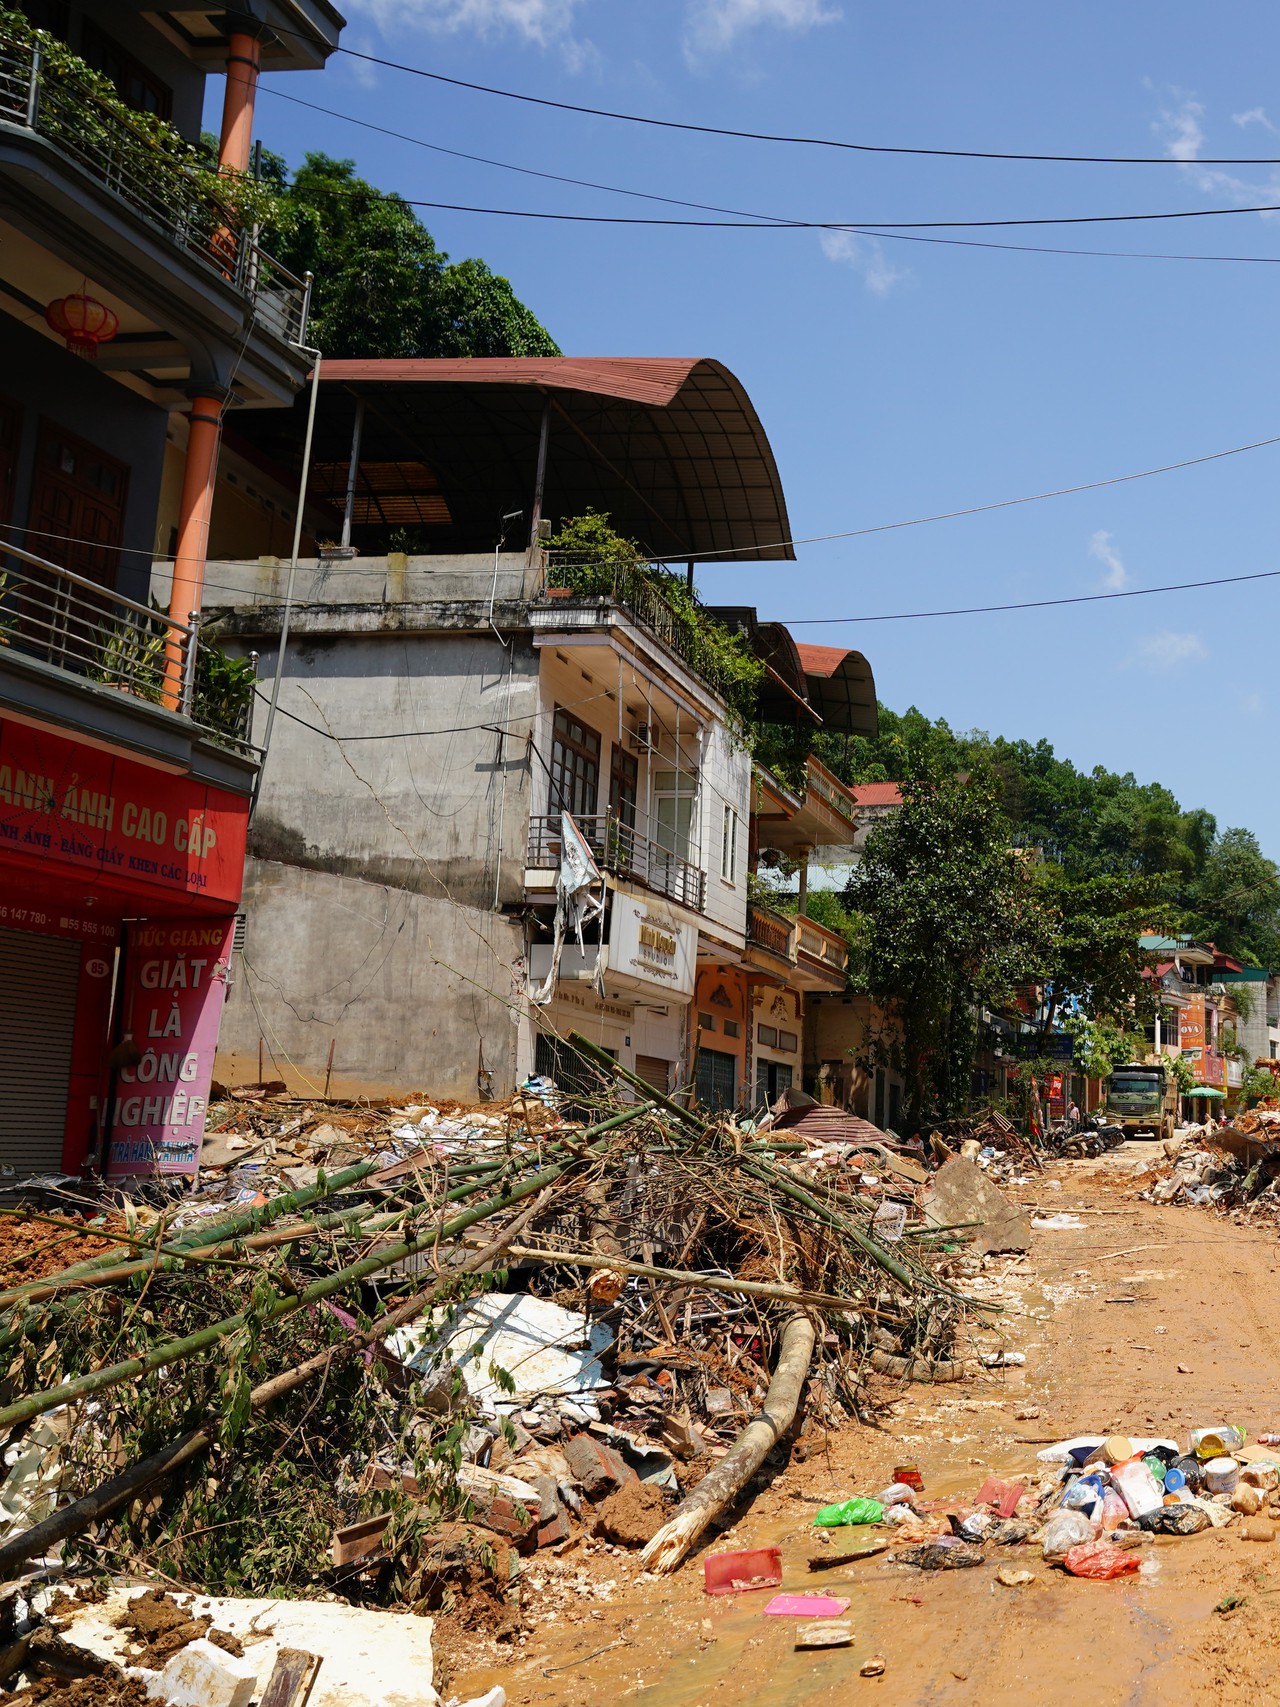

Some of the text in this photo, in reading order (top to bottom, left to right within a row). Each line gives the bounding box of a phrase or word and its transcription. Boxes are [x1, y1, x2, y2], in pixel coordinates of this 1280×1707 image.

[61, 772, 115, 832] ẢNH
[121, 801, 168, 845] CAO
[173, 813, 217, 860] CẤP
[24, 825, 52, 849] ẢNH
[96, 845, 125, 867] GIẤY
[128, 854, 159, 875] KHEN
[160, 862, 182, 881] CÁC
[184, 869, 208, 891] LOẠI
[10, 907, 28, 921] 147
[30, 911, 46, 925] 780
[82, 921, 98, 934] 555
[100, 924, 115, 937] 100
[169, 928, 223, 947] GIANG
[91, 961, 105, 974] 85
[139, 952, 208, 998] GIẶT
[147, 1002, 182, 1038] LÀ
[120, 1047, 199, 1084] CÔNG
